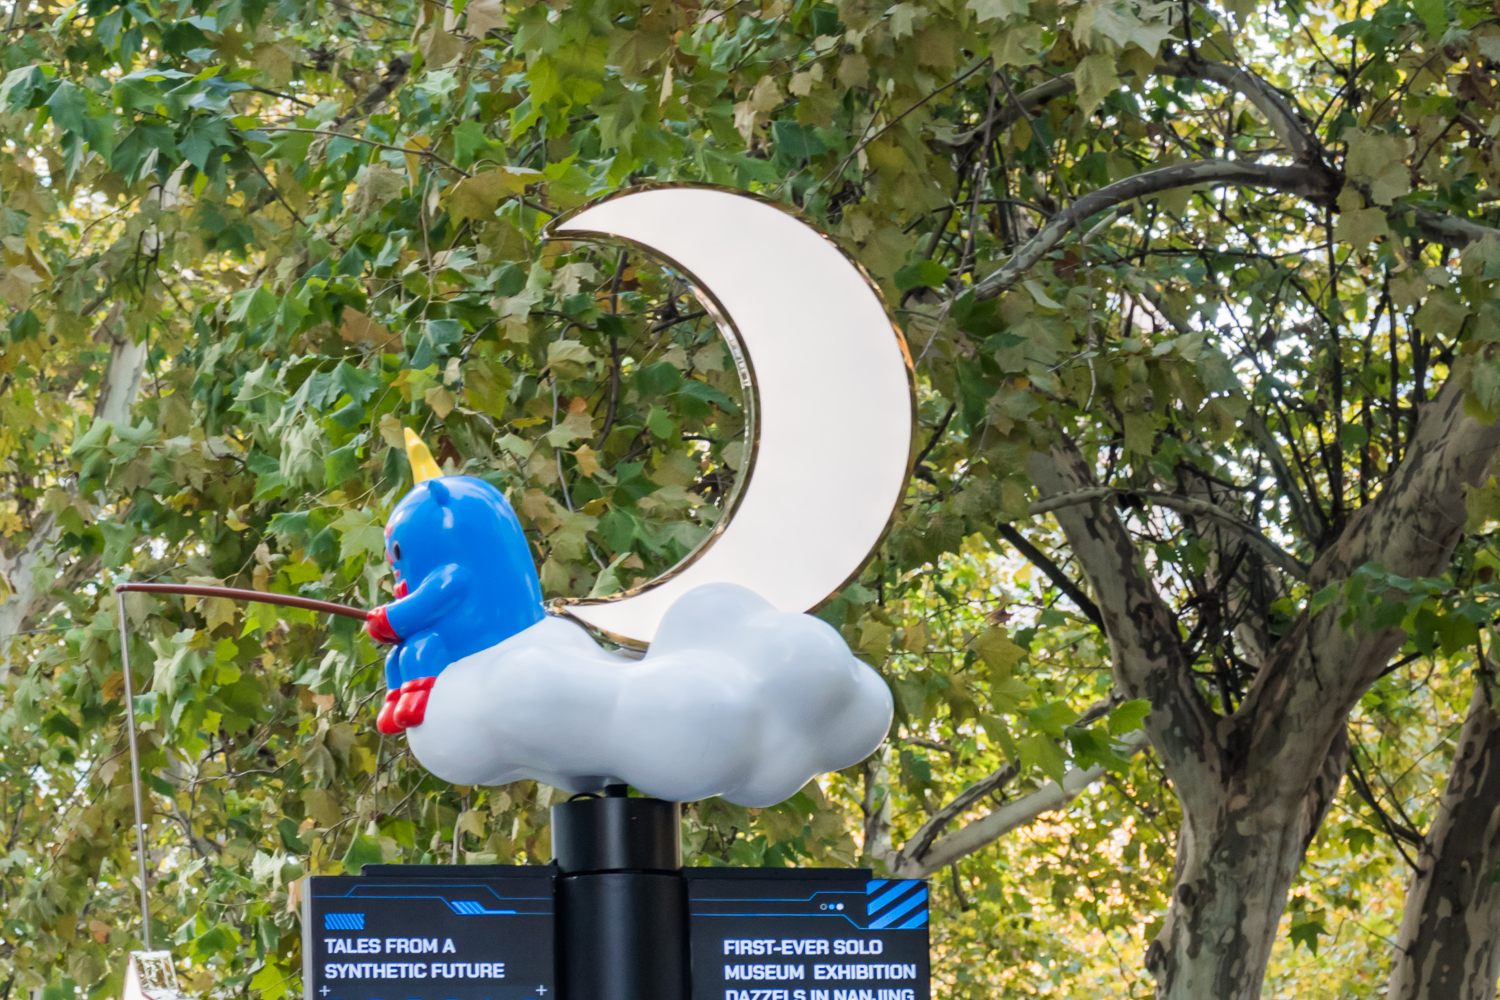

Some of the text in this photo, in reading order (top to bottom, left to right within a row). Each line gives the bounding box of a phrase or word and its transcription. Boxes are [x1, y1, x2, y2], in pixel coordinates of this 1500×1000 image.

[324, 938, 456, 954] TALES FROM A
[723, 939, 883, 955] FIRST-EVER SOLO
[325, 962, 505, 979] SYNTHETIC FUTURE
[724, 964, 917, 980] MUSEUM EXHIBITION
